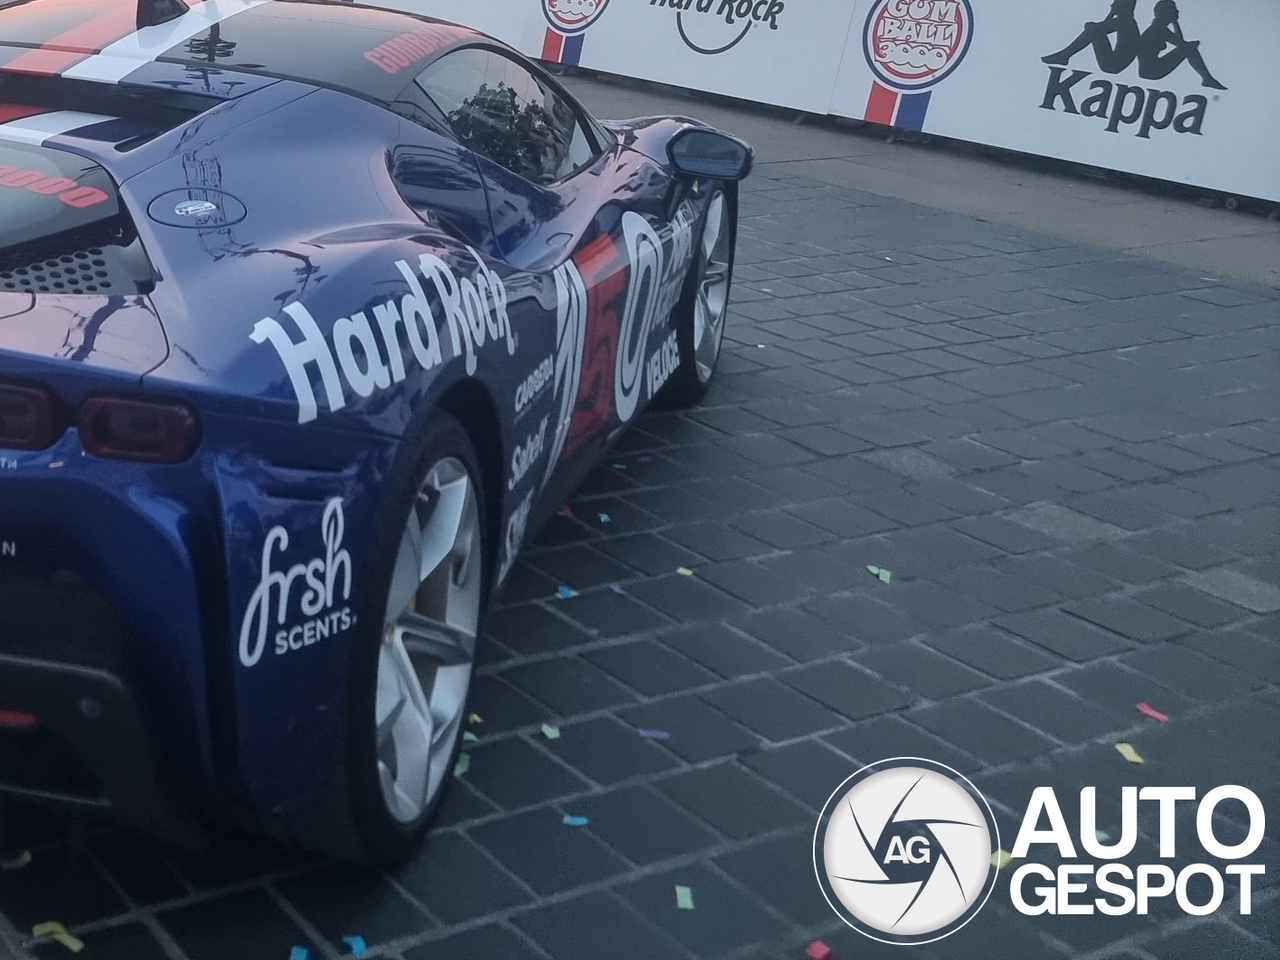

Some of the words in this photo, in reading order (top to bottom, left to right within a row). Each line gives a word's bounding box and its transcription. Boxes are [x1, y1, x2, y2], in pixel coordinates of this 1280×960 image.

[874, 40, 948, 70] 3000
[878, 17, 959, 48] BALL
[1039, 66, 1210, 139] Kappa
[249, 260, 445, 425] Hard
[419, 246, 515, 376] Rock
[239, 496, 352, 667] frsh
[275, 606, 352, 655] SCENTS
